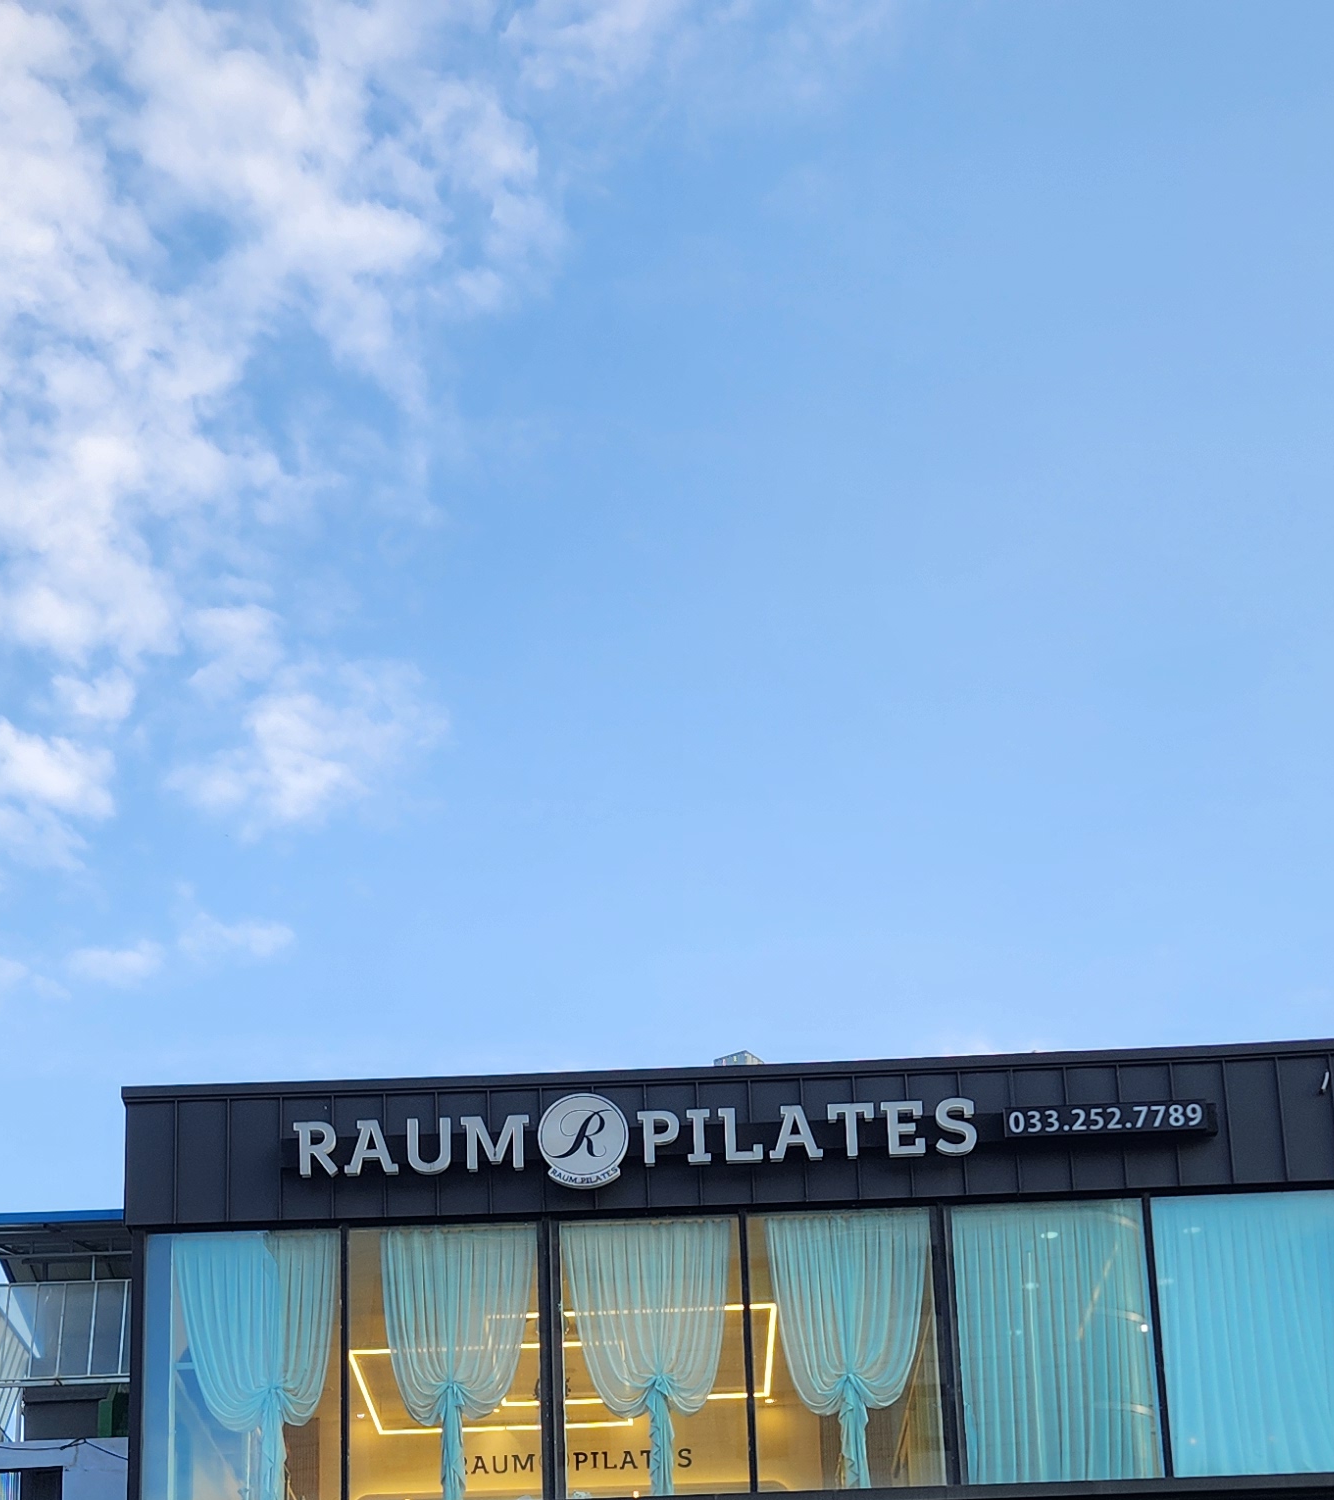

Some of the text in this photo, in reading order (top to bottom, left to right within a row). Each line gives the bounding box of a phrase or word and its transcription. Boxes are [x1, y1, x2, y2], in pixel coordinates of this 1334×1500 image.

[1008, 1103, 1203, 1134] 033.252.7789
[293, 1097, 978, 1178] RAUM PILATES
[550, 1166, 618, 1184] RAUM PILATES
[573, 1448, 692, 1472] PILATS
